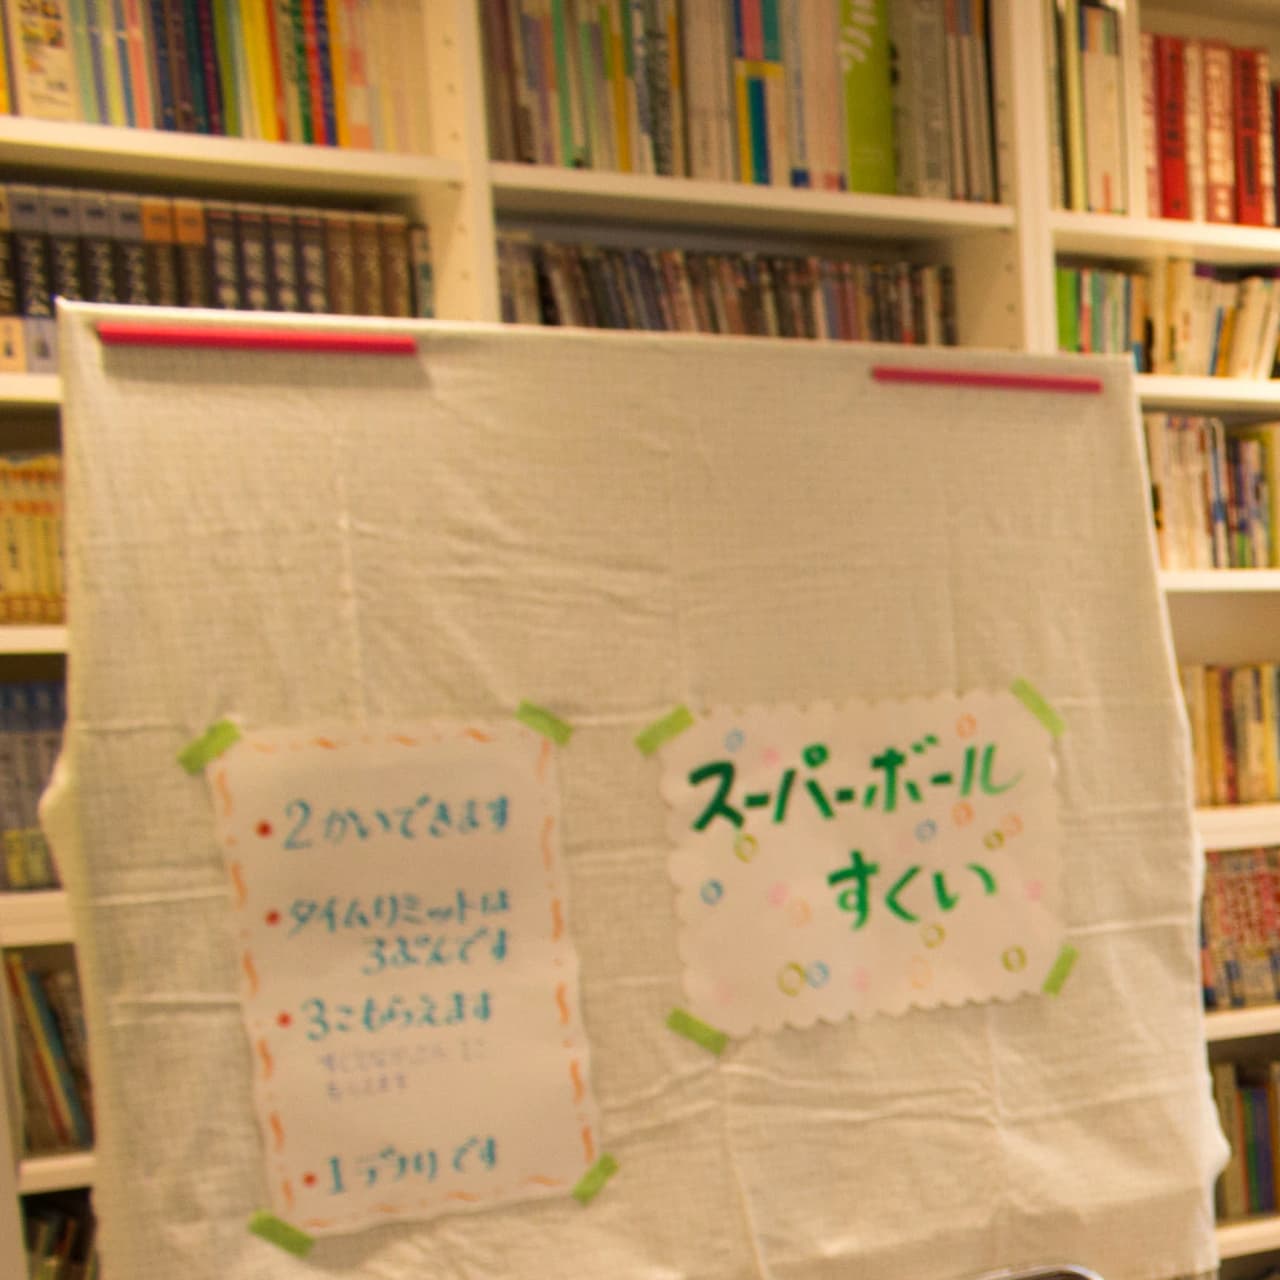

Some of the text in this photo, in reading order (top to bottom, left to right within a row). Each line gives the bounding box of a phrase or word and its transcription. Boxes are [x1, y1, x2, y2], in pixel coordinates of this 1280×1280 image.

[688, 734, 1024, 832] スーパーボール
[827, 849, 999, 930] すくい
